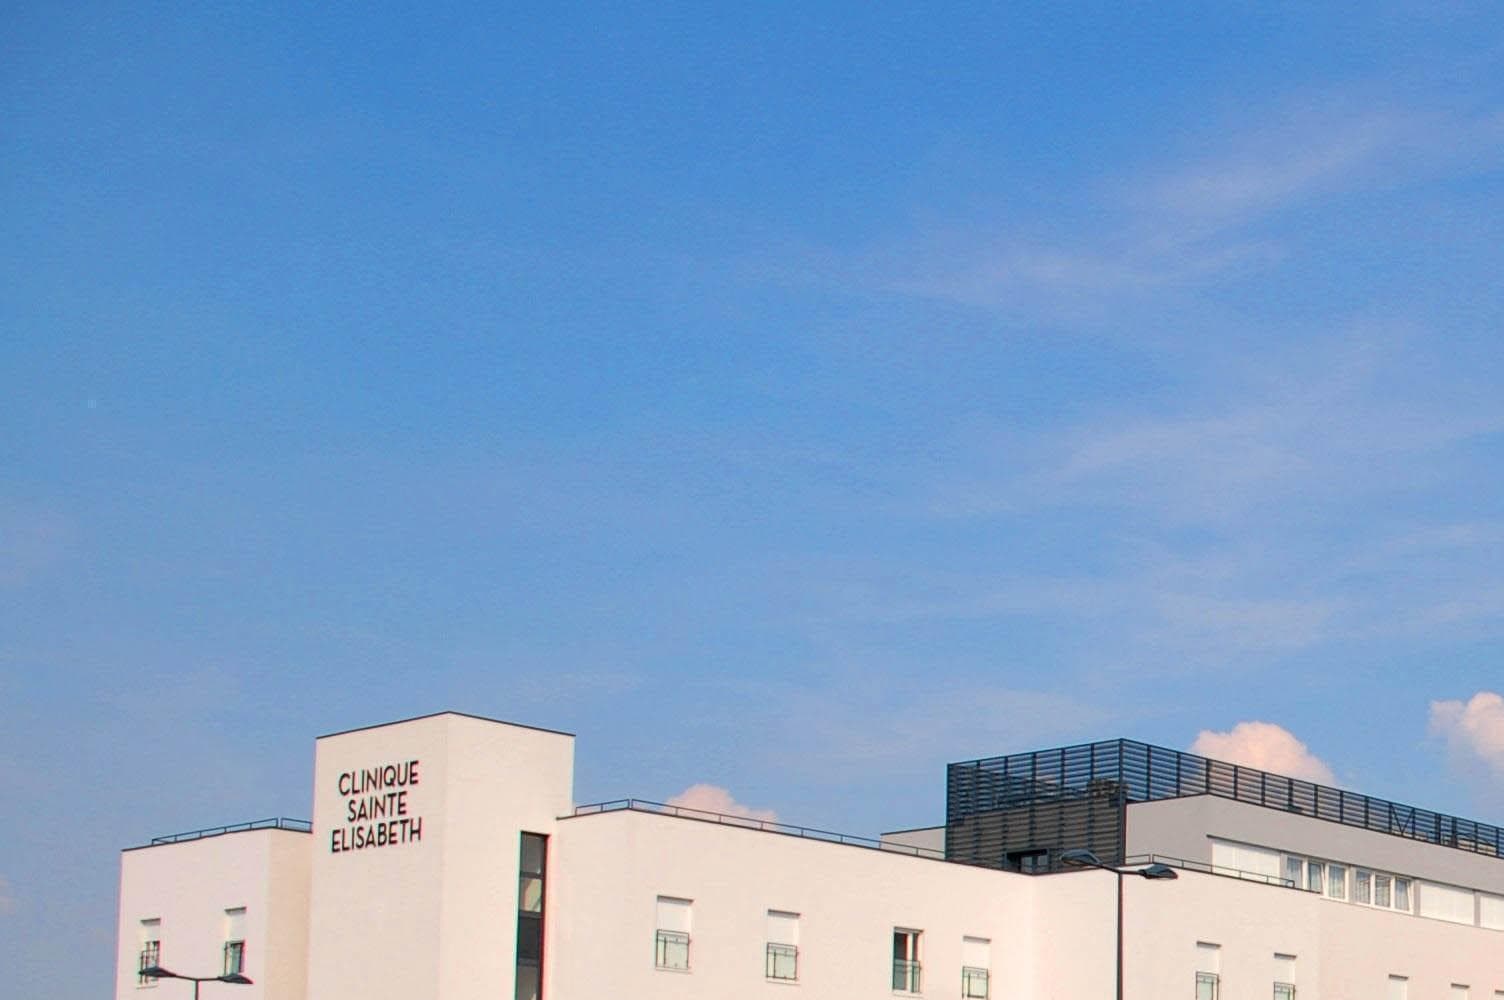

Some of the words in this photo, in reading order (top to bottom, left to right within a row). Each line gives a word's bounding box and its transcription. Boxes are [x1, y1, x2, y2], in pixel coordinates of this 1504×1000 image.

[338, 760, 420, 796] CLINIQUE
[347, 791, 408, 823] SAINTE
[331, 817, 422, 853] ELISABETH
